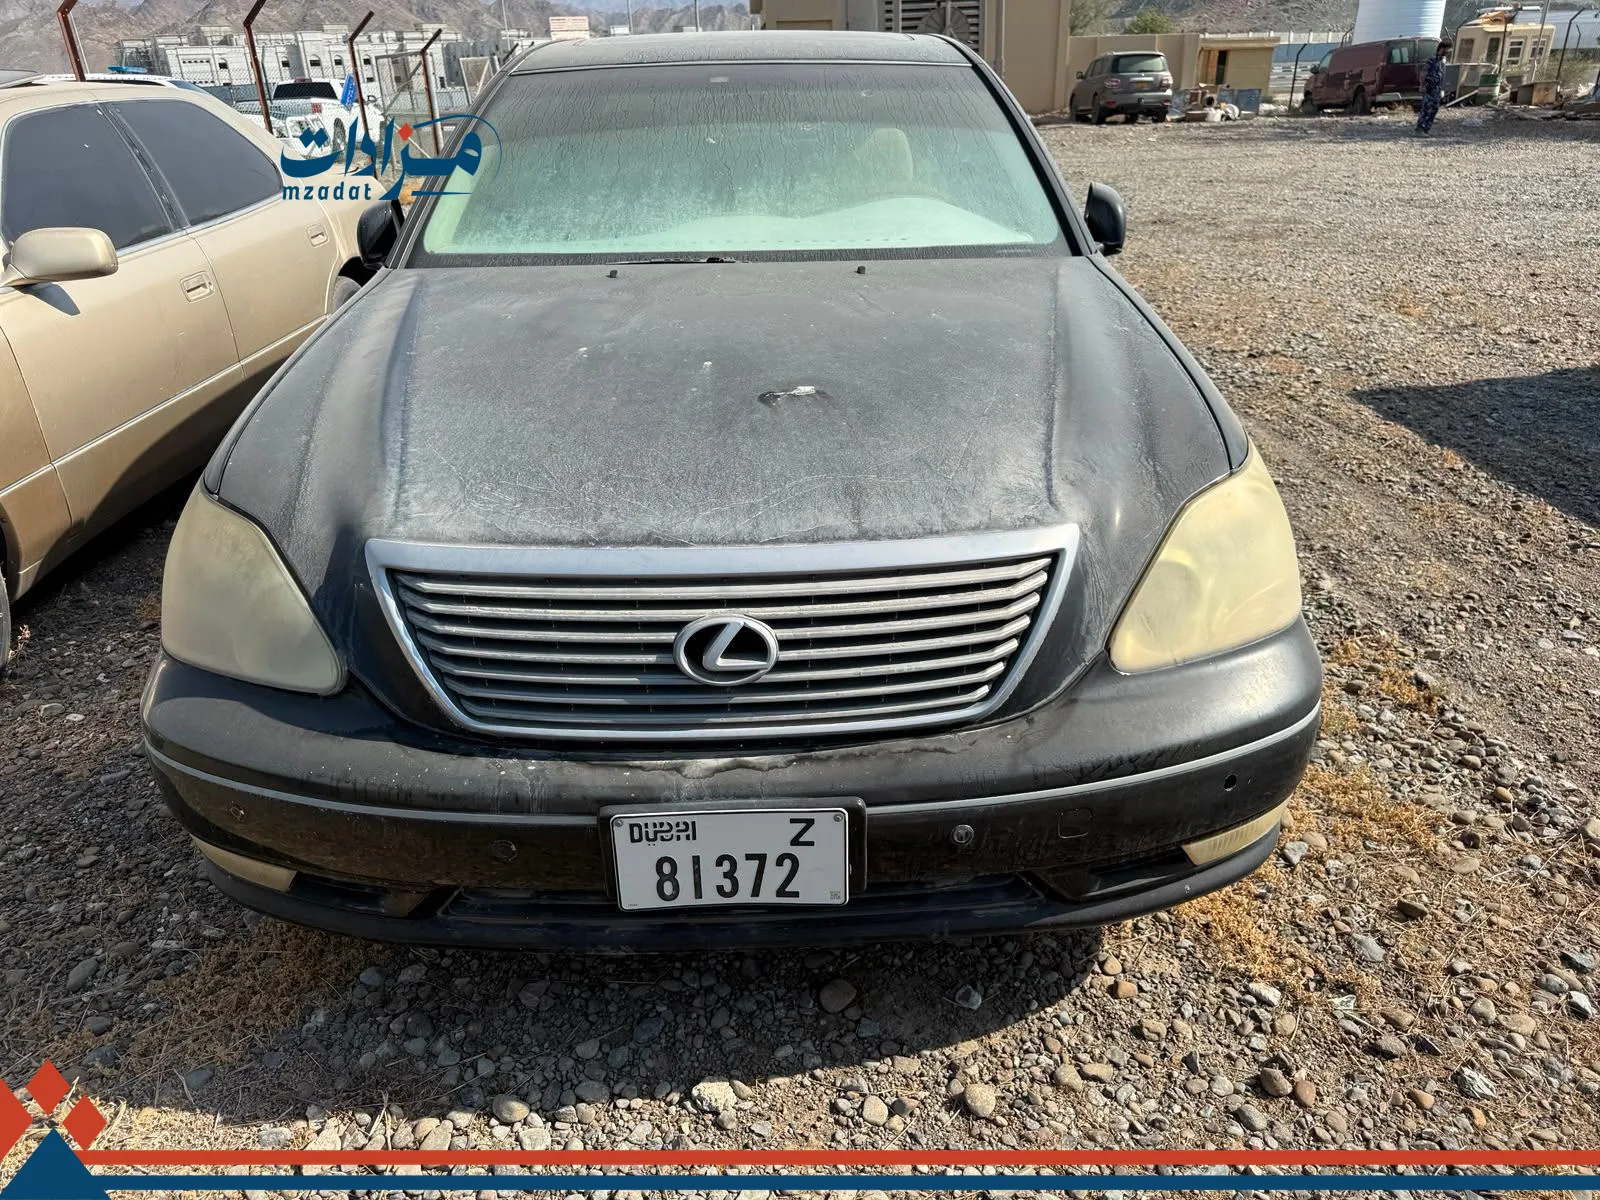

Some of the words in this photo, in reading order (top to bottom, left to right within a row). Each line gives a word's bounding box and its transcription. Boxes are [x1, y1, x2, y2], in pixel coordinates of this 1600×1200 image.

[628, 820, 697, 846] DUBAI
[789, 818, 815, 846] Z
[655, 852, 800, 901] 81372
